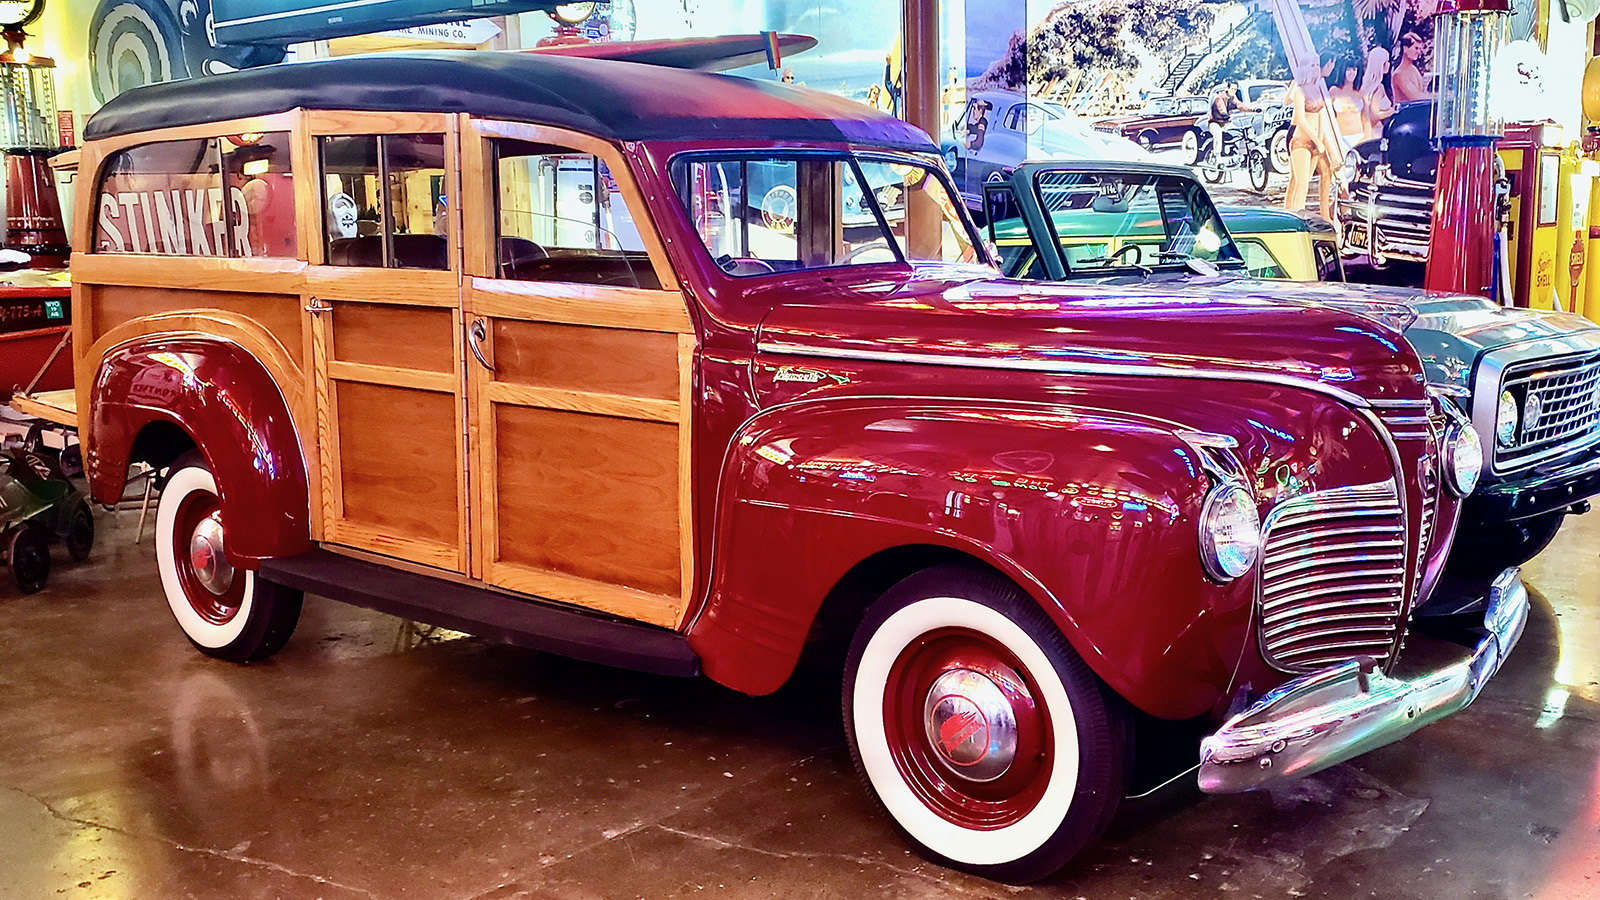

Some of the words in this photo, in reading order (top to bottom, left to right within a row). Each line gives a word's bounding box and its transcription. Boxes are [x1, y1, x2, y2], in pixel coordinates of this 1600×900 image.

[418, 27, 449, 37] MINING
[452, 29, 466, 39] CO.
[99, 187, 253, 257] STINKER
